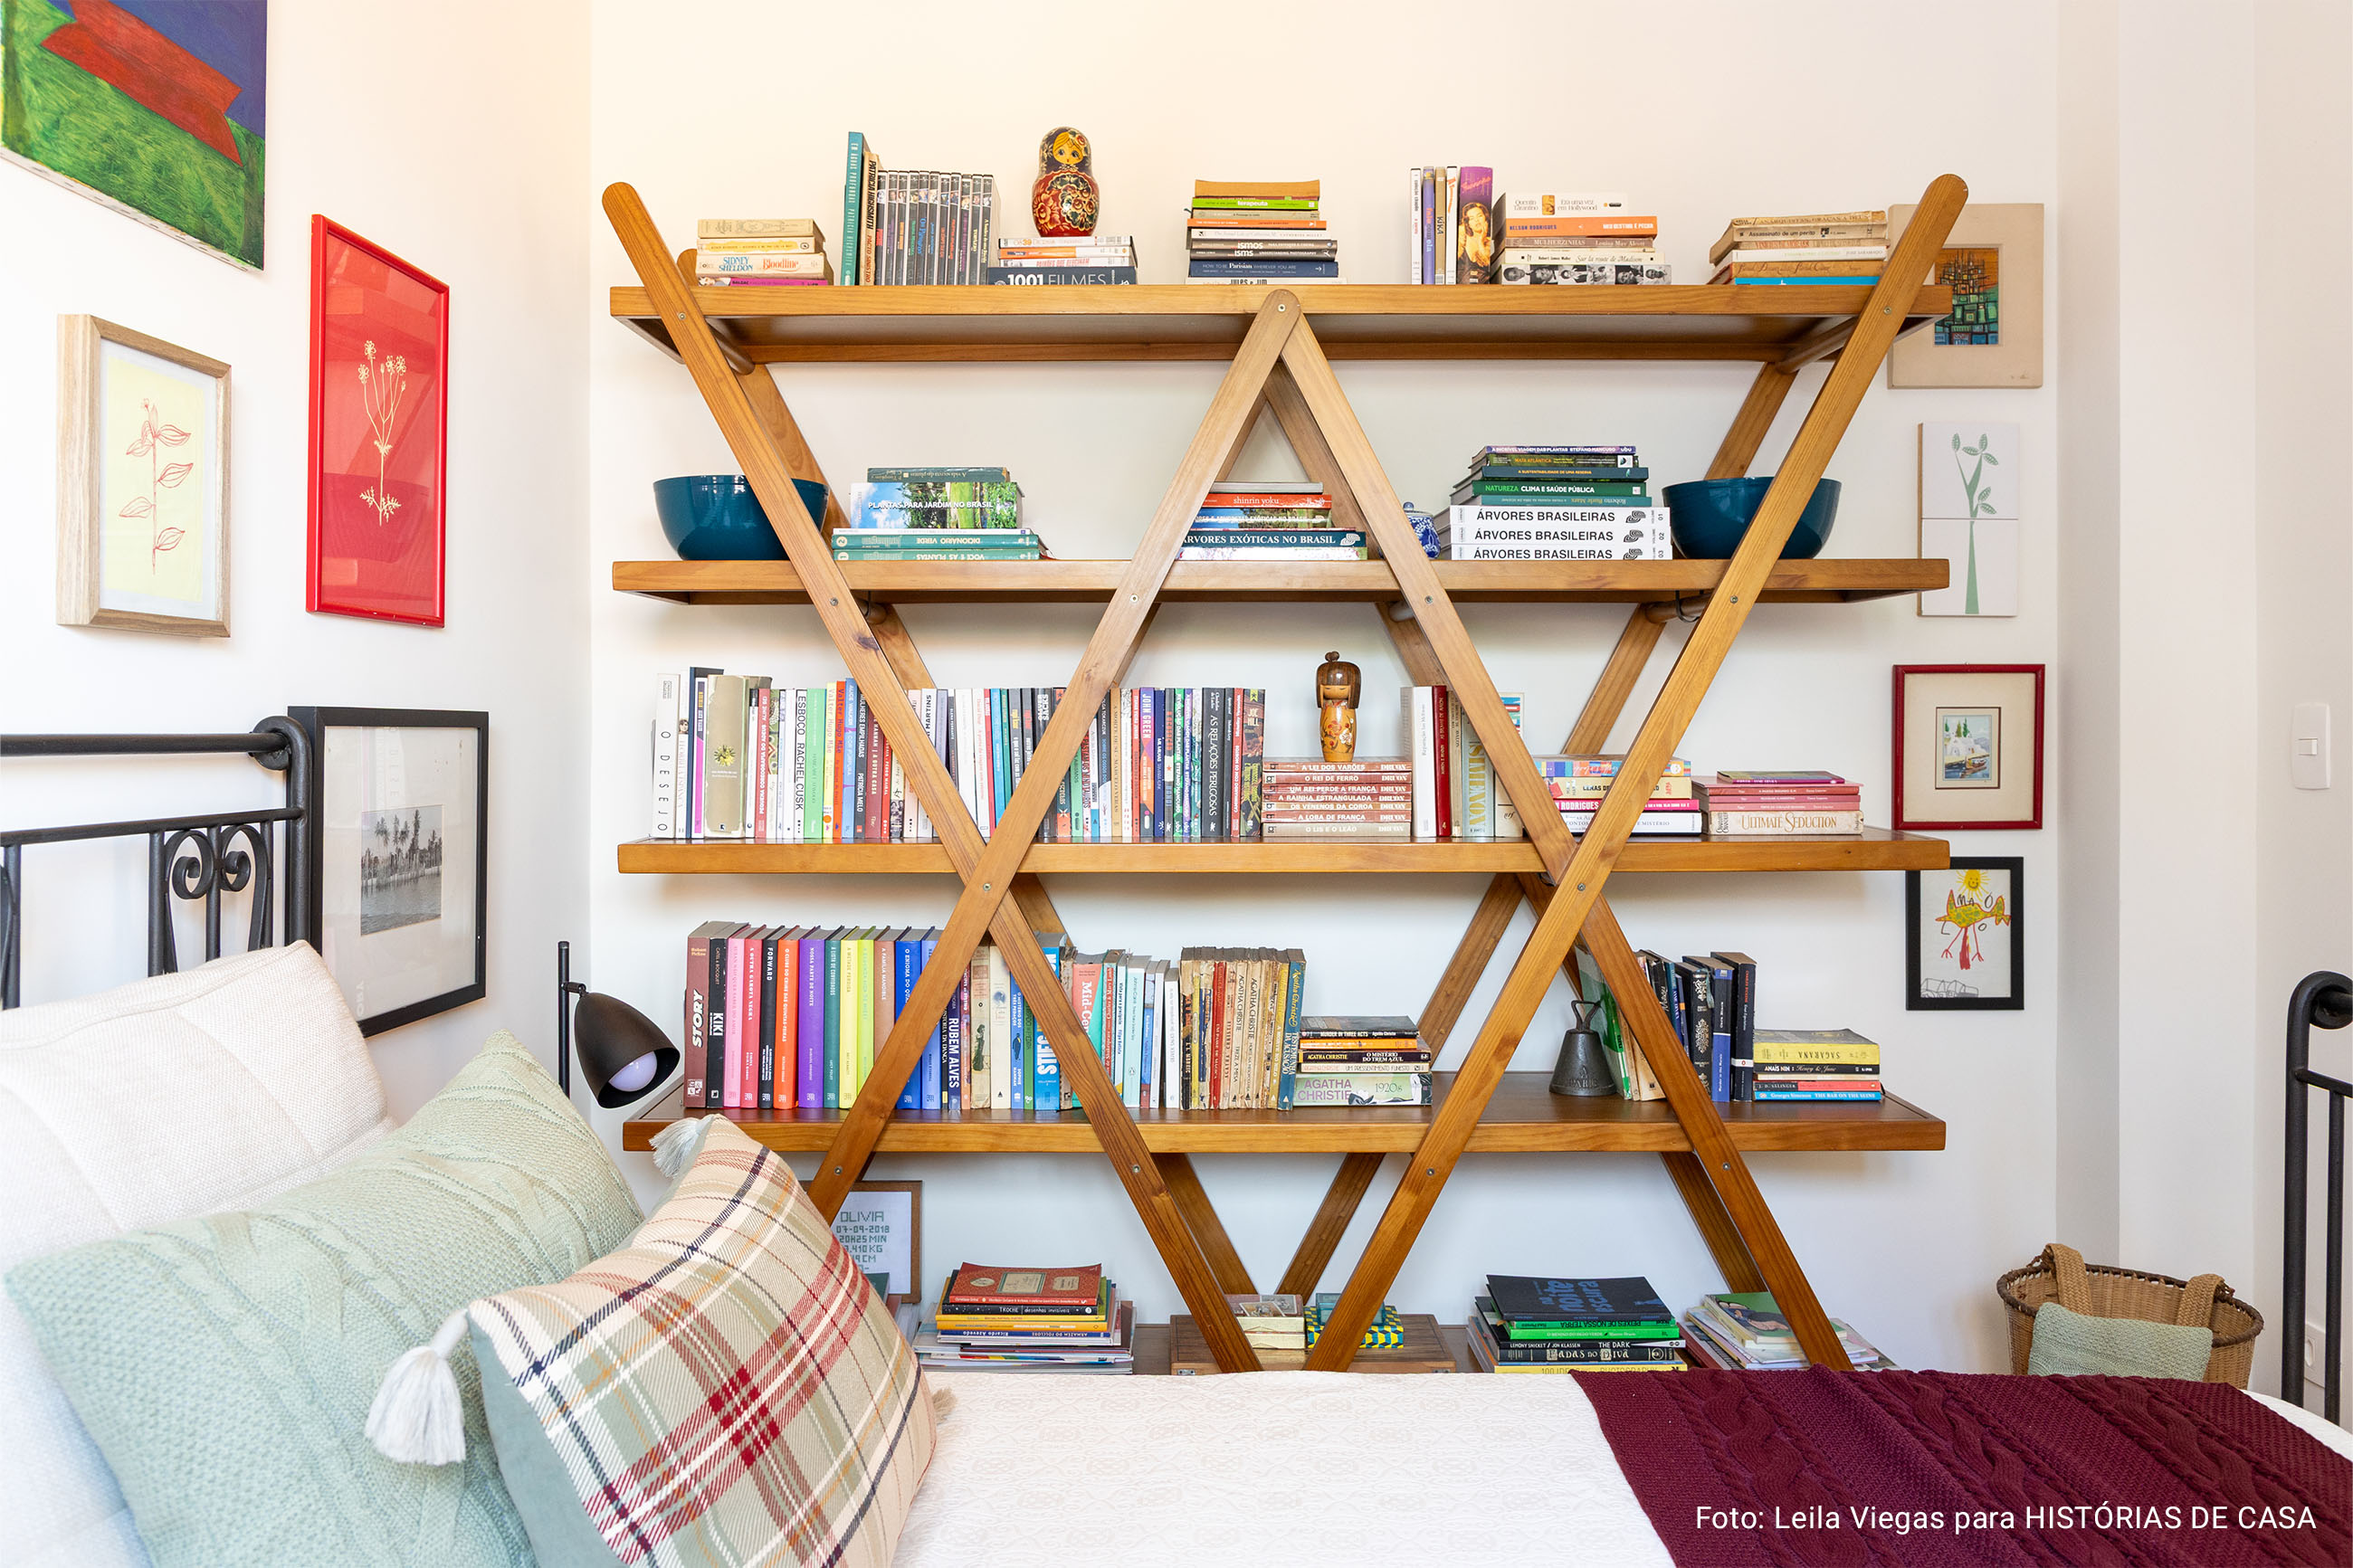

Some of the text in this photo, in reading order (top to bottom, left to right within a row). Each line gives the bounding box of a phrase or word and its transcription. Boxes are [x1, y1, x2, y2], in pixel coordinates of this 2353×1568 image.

[867, 160, 876, 230] PATRICIA HIGHSMITH
[1238, 241, 1263, 249] ismos
[723, 257, 749, 265] SIDNEY
[763, 259, 800, 270] Bloodline
[1008, 273, 1106, 285] 1001 FILMES
[1547, 484, 1567, 492] SAÚDE
[967, 500, 994, 508] BRASIL
[1234, 496, 1279, 506] shinrin yoku
[1477, 508, 1615, 521] ÁRVORES BRASILEIRAS
[1230, 534, 1280, 543] EXÓTICAS
[1475, 527, 1613, 540] ÁRVORES BRASILEIRAS
[1473, 546, 1613, 558] ÁRVORES BRASILEIRAS
[1142, 694, 1151, 738] JOHN GREEN
[795, 696, 805, 810] ESBOÇO RACHEL CUSK
[1208, 716, 1219, 816] AS RELAÇÕES PERIGOSAS
[1469, 744, 1486, 826] SIMENON
[657, 755, 670, 831] DESEJO
[1558, 802, 1598, 810] RODRIGUES
[1741, 812, 1837, 832] ULTIMATE SEDUCTION
[784, 968, 788, 976] DO
[905, 979, 910, 987] DO
[1249, 978, 1257, 1007] AGATHA
[1289, 970, 1301, 1027] Agatha Christie
[692, 989, 704, 1048] STORY
[713, 1012, 723, 1035] KIKI
[948, 1018, 959, 1088] RUBEM ALVES
[1273, 1052, 1280, 1062] NO
[1281, 1032, 1291, 1075] DA ACUSAÇÃO
[1288, 1031, 1299, 1075] TESTEMUNHA
[1304, 1079, 1351, 1088] AGATHA
[1375, 1083, 1403, 1092] 1920s
[1298, 1090, 1351, 1100] CHRISTIE
[840, 1212, 883, 1222] OLIVIA
[836, 1225, 890, 1233] 07-09-2018
[840, 1235, 867, 1243] 20H25
